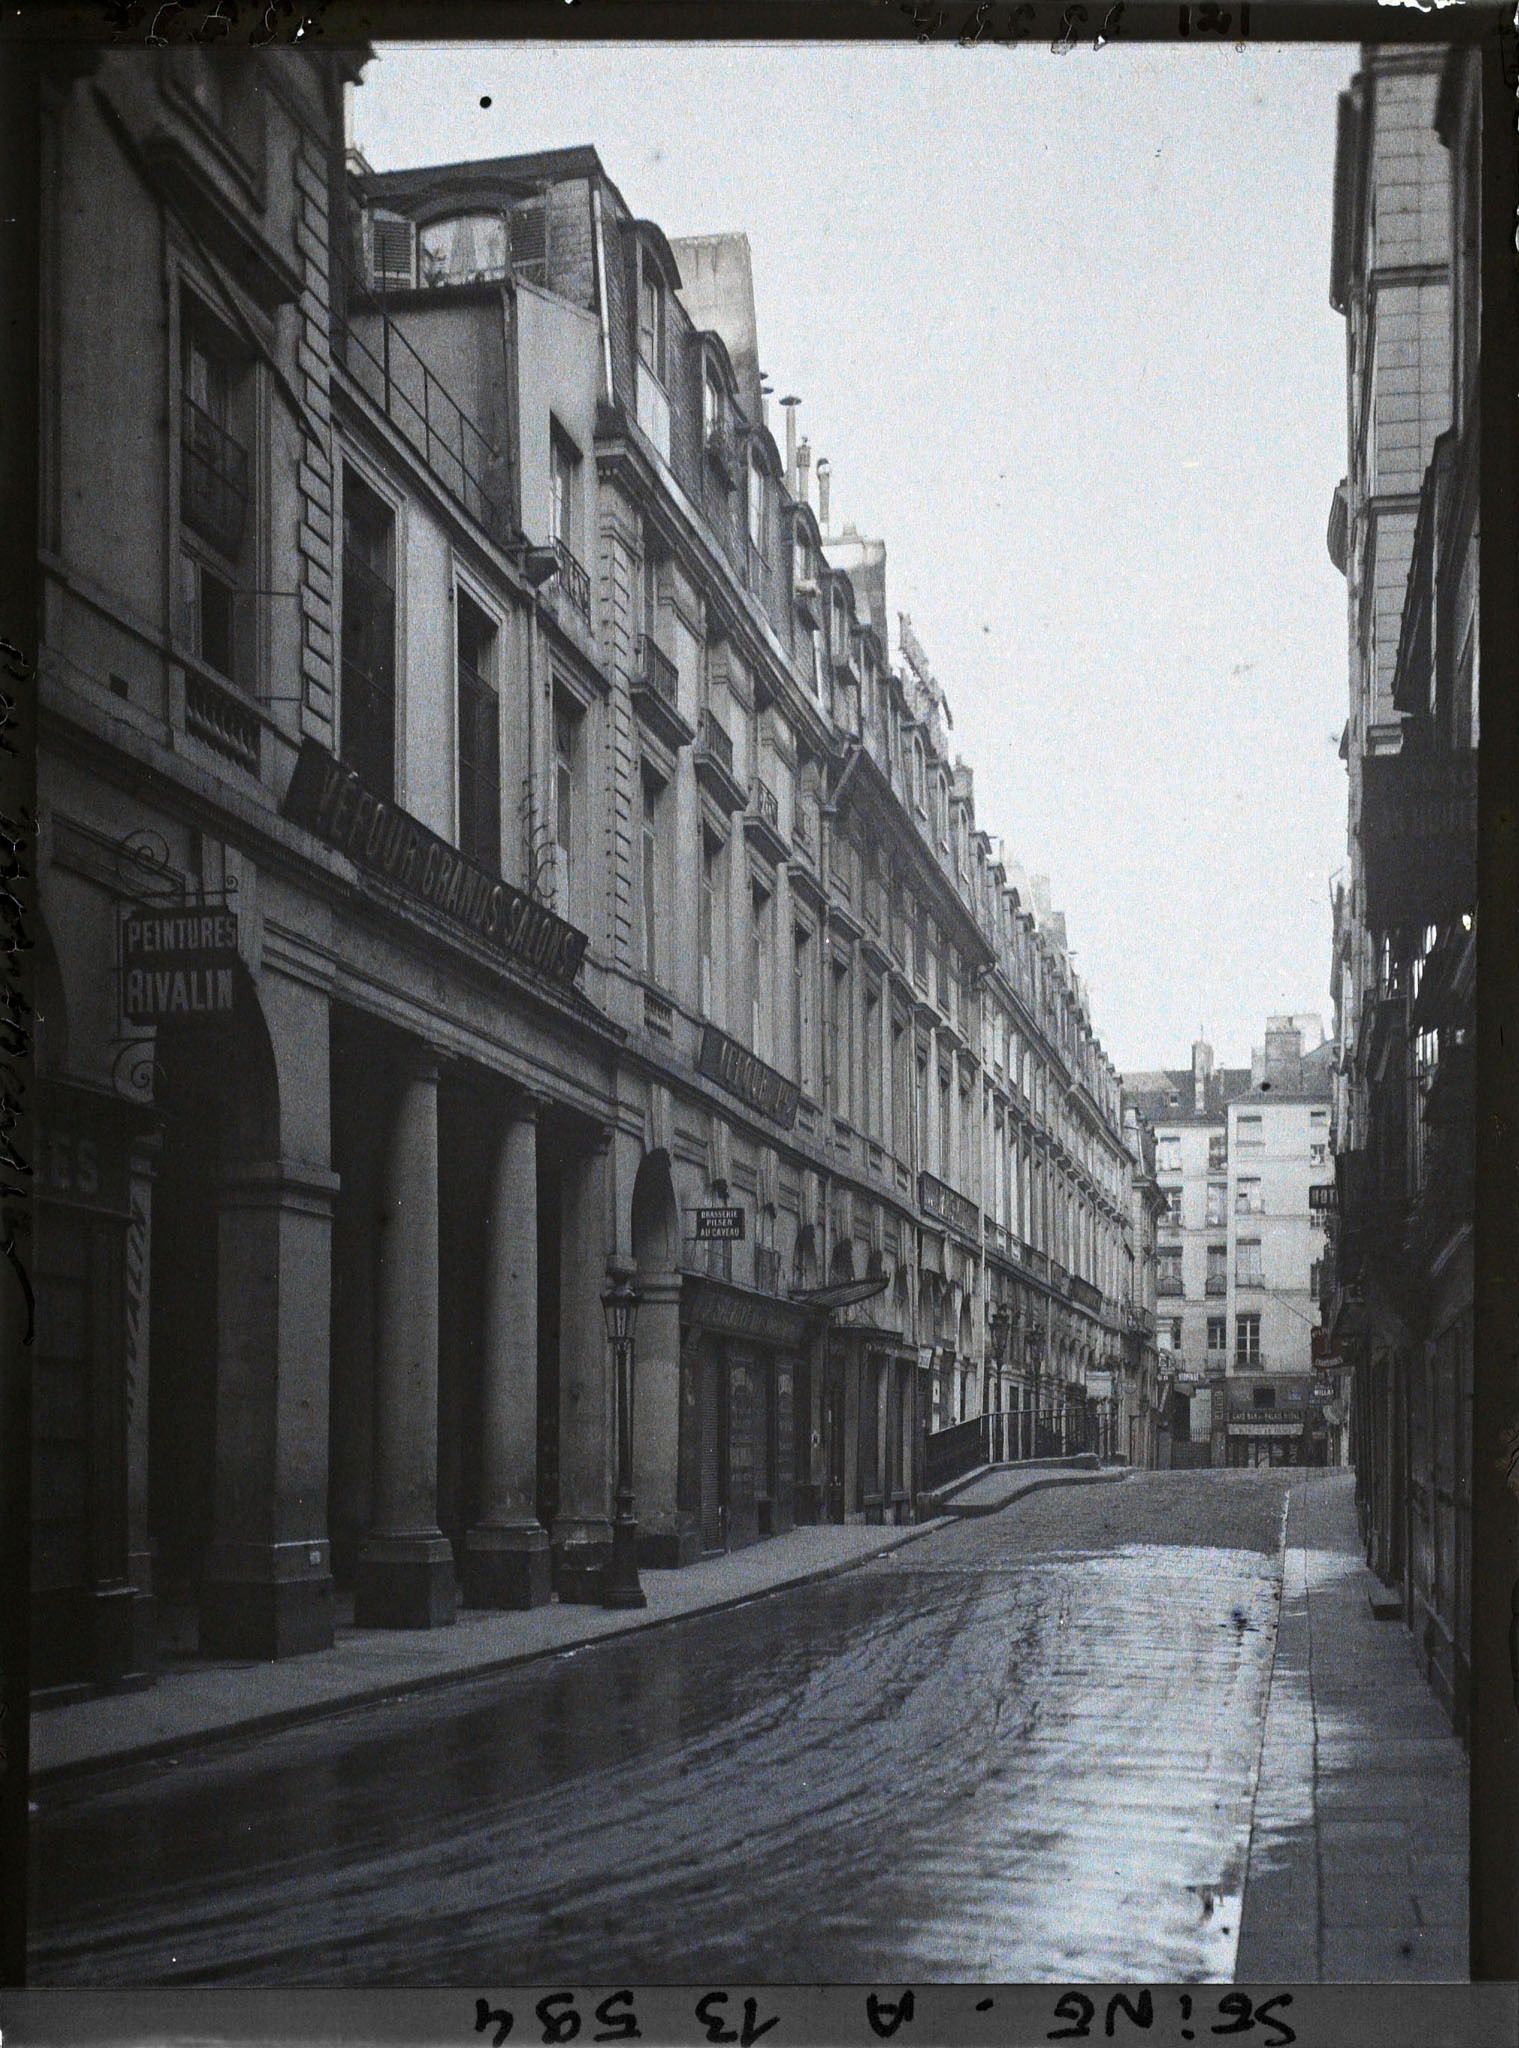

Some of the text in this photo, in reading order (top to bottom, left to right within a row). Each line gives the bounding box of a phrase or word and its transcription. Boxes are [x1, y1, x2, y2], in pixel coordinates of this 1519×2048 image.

[422, 843, 504, 932] GRANDS
[505, 897, 577, 977] SALONS
[128, 917, 236, 952] PEINTURES
[127, 969, 233, 1013] RIVALIN
[700, 1227, 740, 1237] AU CAVEAU
[701, 1210, 738, 1219] BRASSERIE
[476, 1992, 643, 2048] 594
[696, 1993, 781, 2047] 13
[868, 1992, 916, 2040] A
